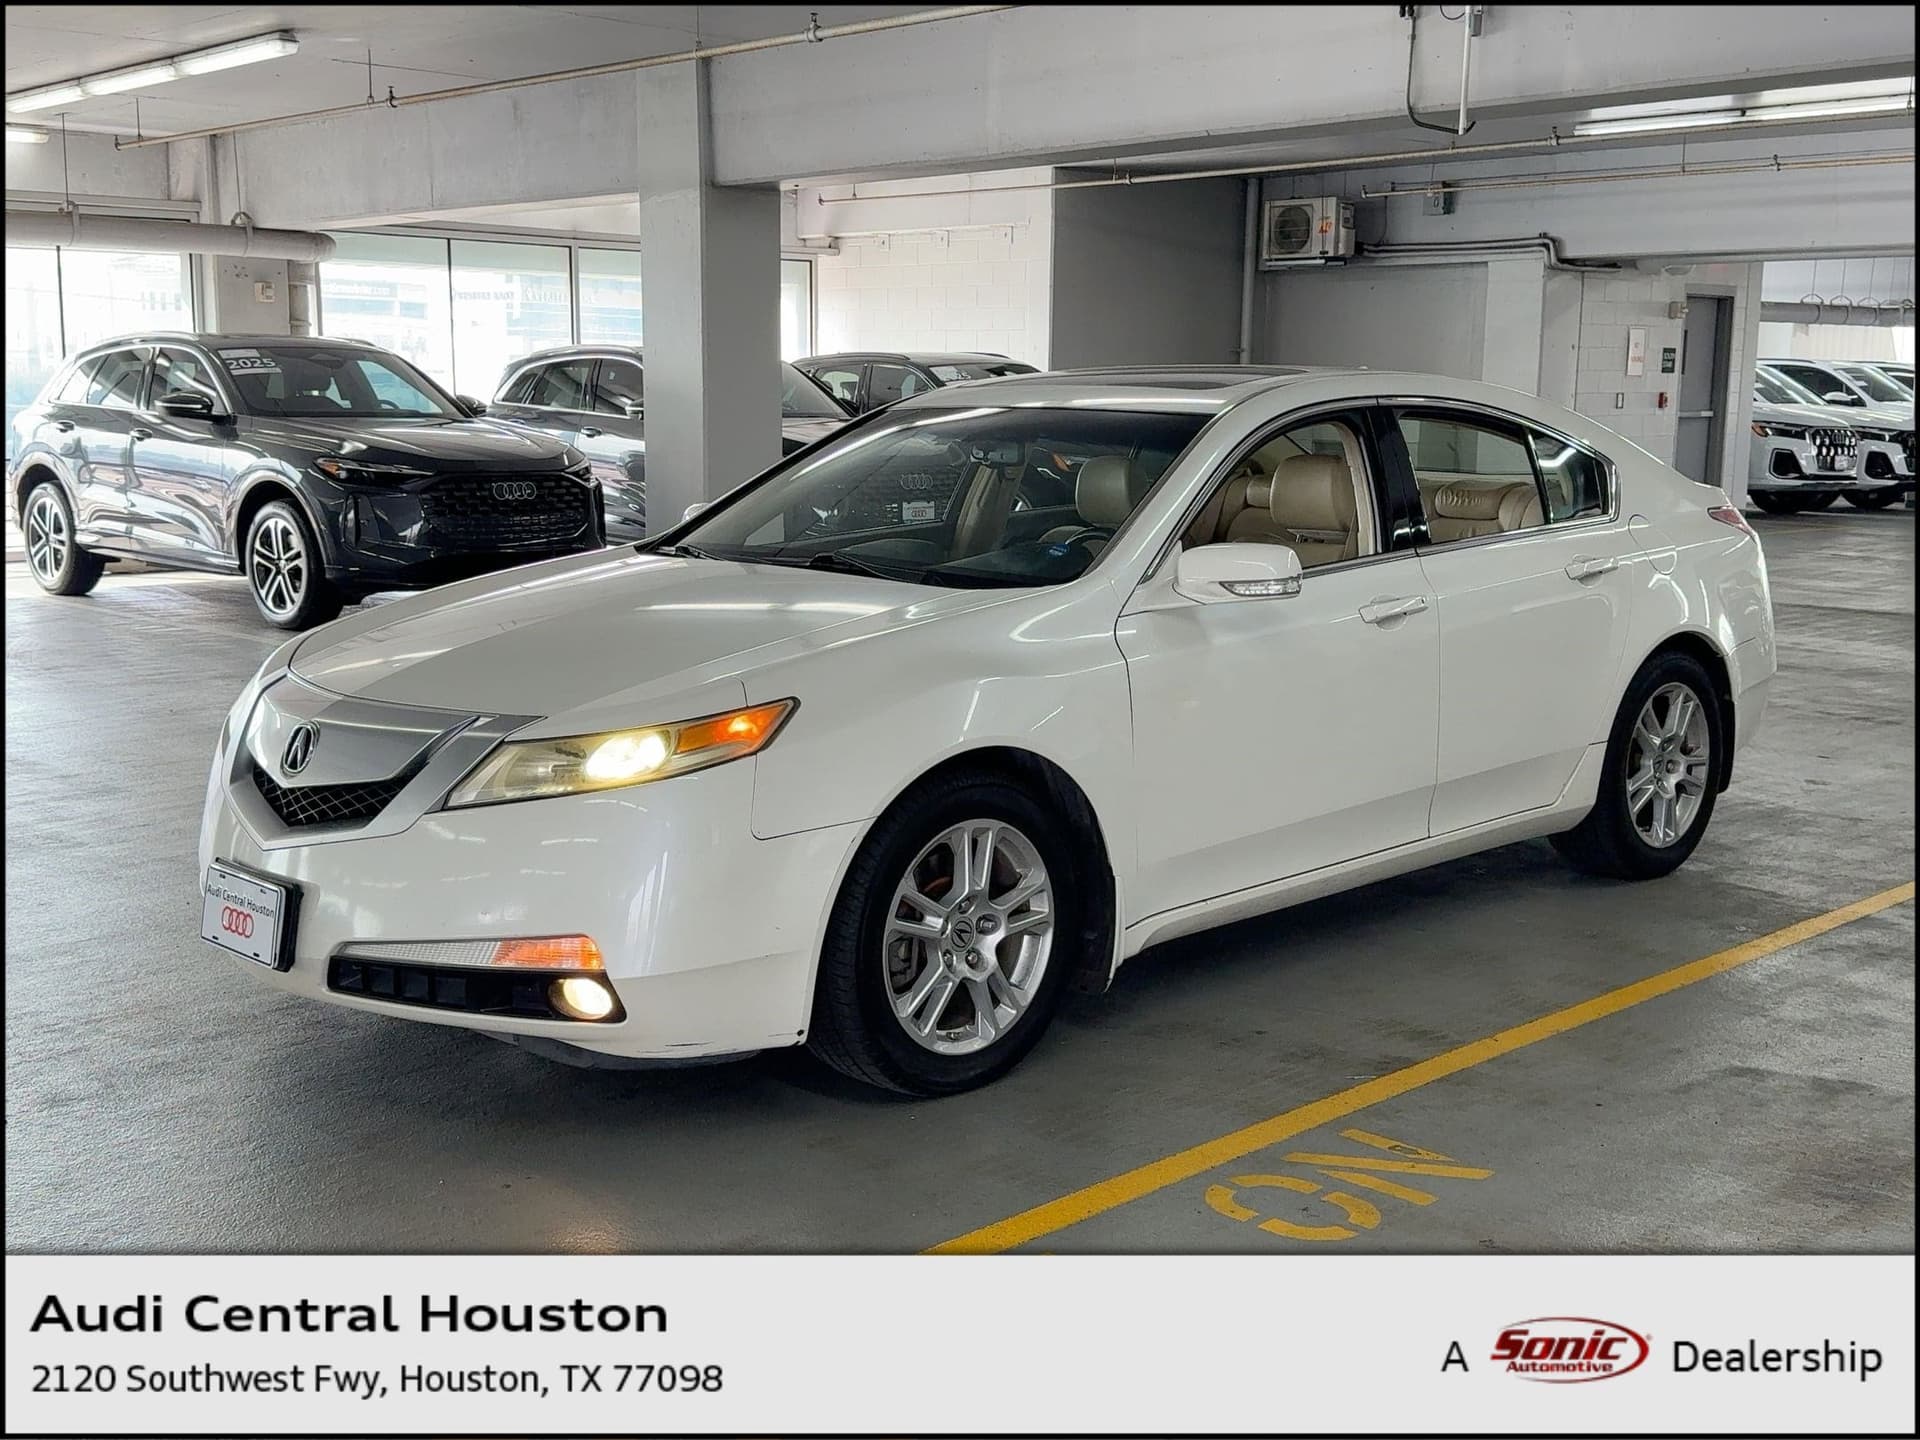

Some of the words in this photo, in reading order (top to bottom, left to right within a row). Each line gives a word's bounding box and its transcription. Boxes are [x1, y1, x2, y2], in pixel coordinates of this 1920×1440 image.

[225, 358, 276, 370] 2025
[207, 883, 222, 898] Audi
[222, 888, 246, 907] Central
[246, 897, 275, 919] Houston
